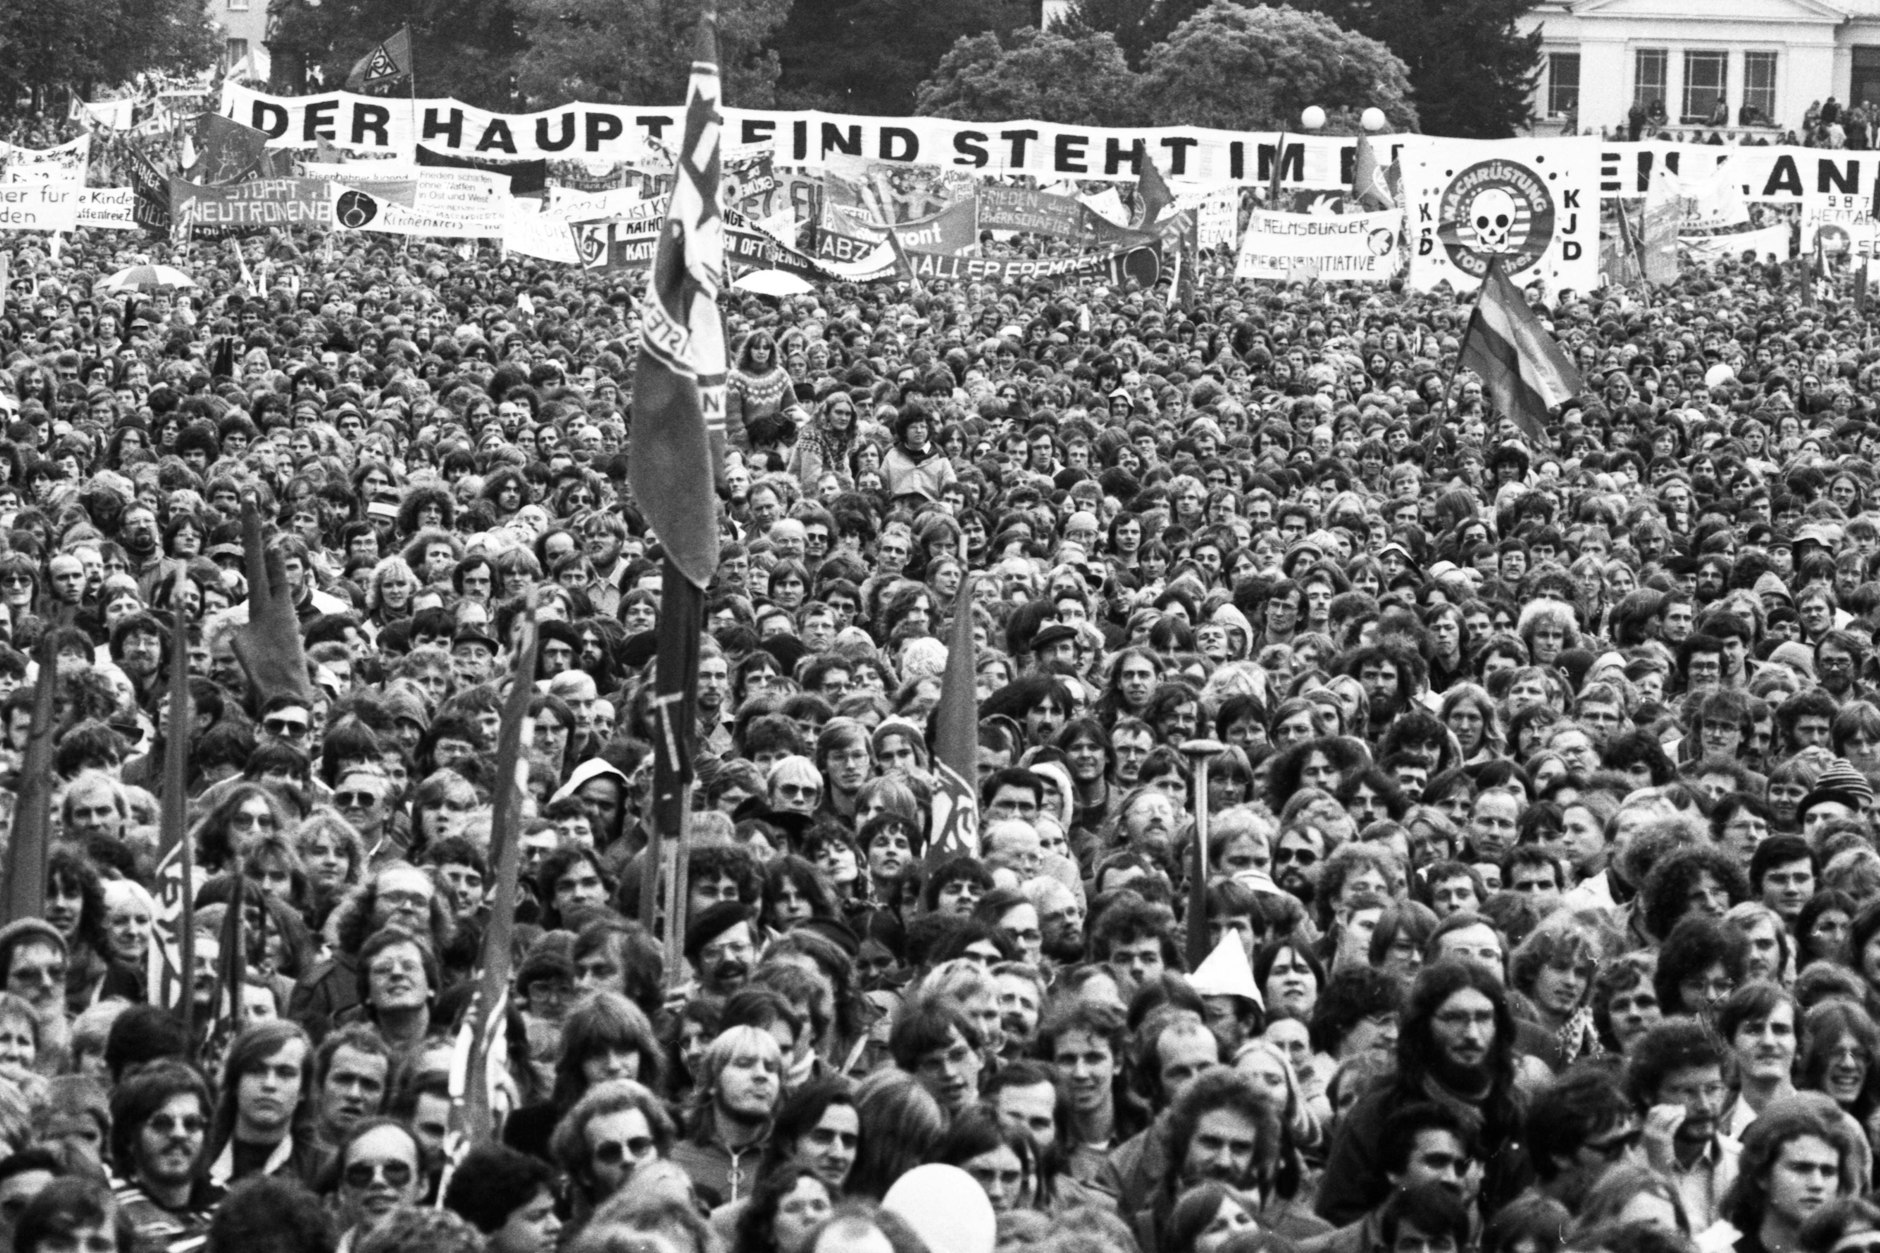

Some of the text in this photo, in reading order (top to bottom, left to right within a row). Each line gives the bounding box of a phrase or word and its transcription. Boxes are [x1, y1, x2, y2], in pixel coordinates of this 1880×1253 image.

[252, 100, 390, 146] DER
[422, 107, 919, 163] HAUPTEIND
[953, 129, 1198, 176] STEHT
[1230, 141, 1305, 182] IM
[1443, 162, 1548, 223] NACHRÜSTUNG
[741, 237, 763, 258] OFT
[1455, 248, 1488, 274] TOD
